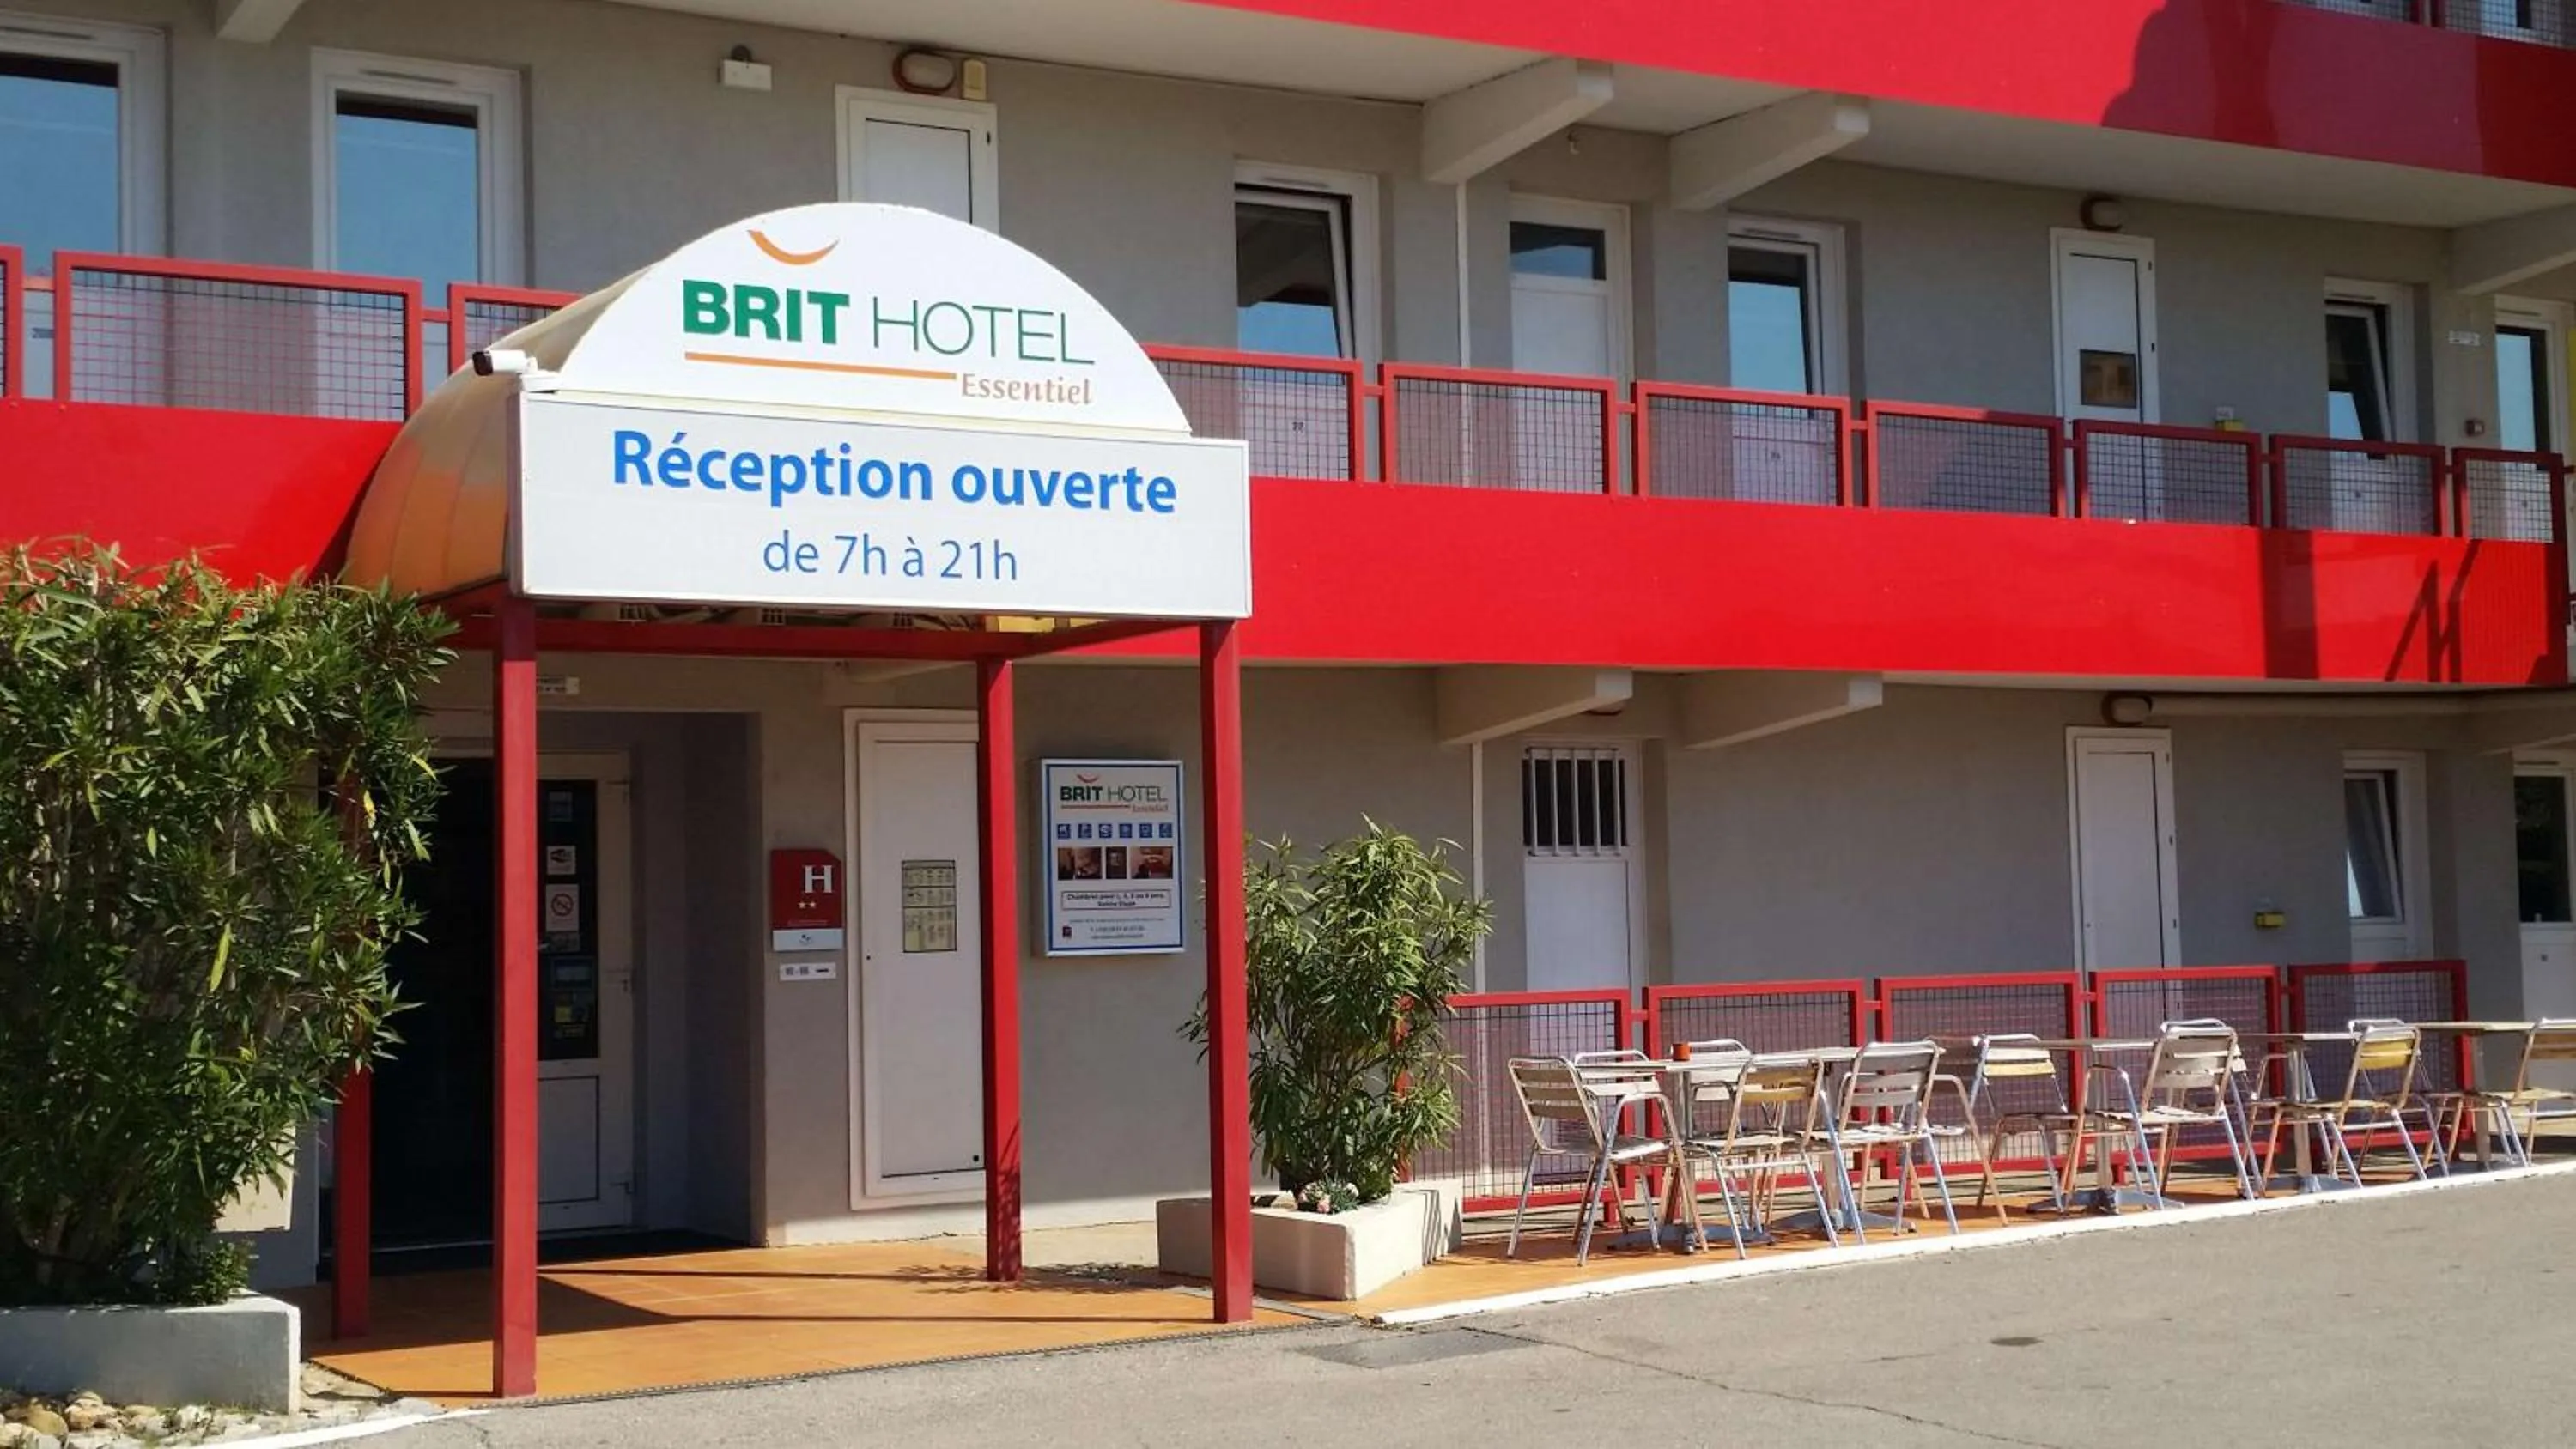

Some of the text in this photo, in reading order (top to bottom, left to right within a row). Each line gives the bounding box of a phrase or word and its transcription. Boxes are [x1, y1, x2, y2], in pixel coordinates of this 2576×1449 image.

[683, 279, 1095, 365] BRIT HOTEL
[961, 372, 1092, 406] Essentiel
[613, 429, 1177, 513] Réception ouverte
[763, 530, 1017, 581] de 7h à 21h
[1060, 785, 1168, 803] BRIT HOTEL
[805, 865, 833, 893] H
